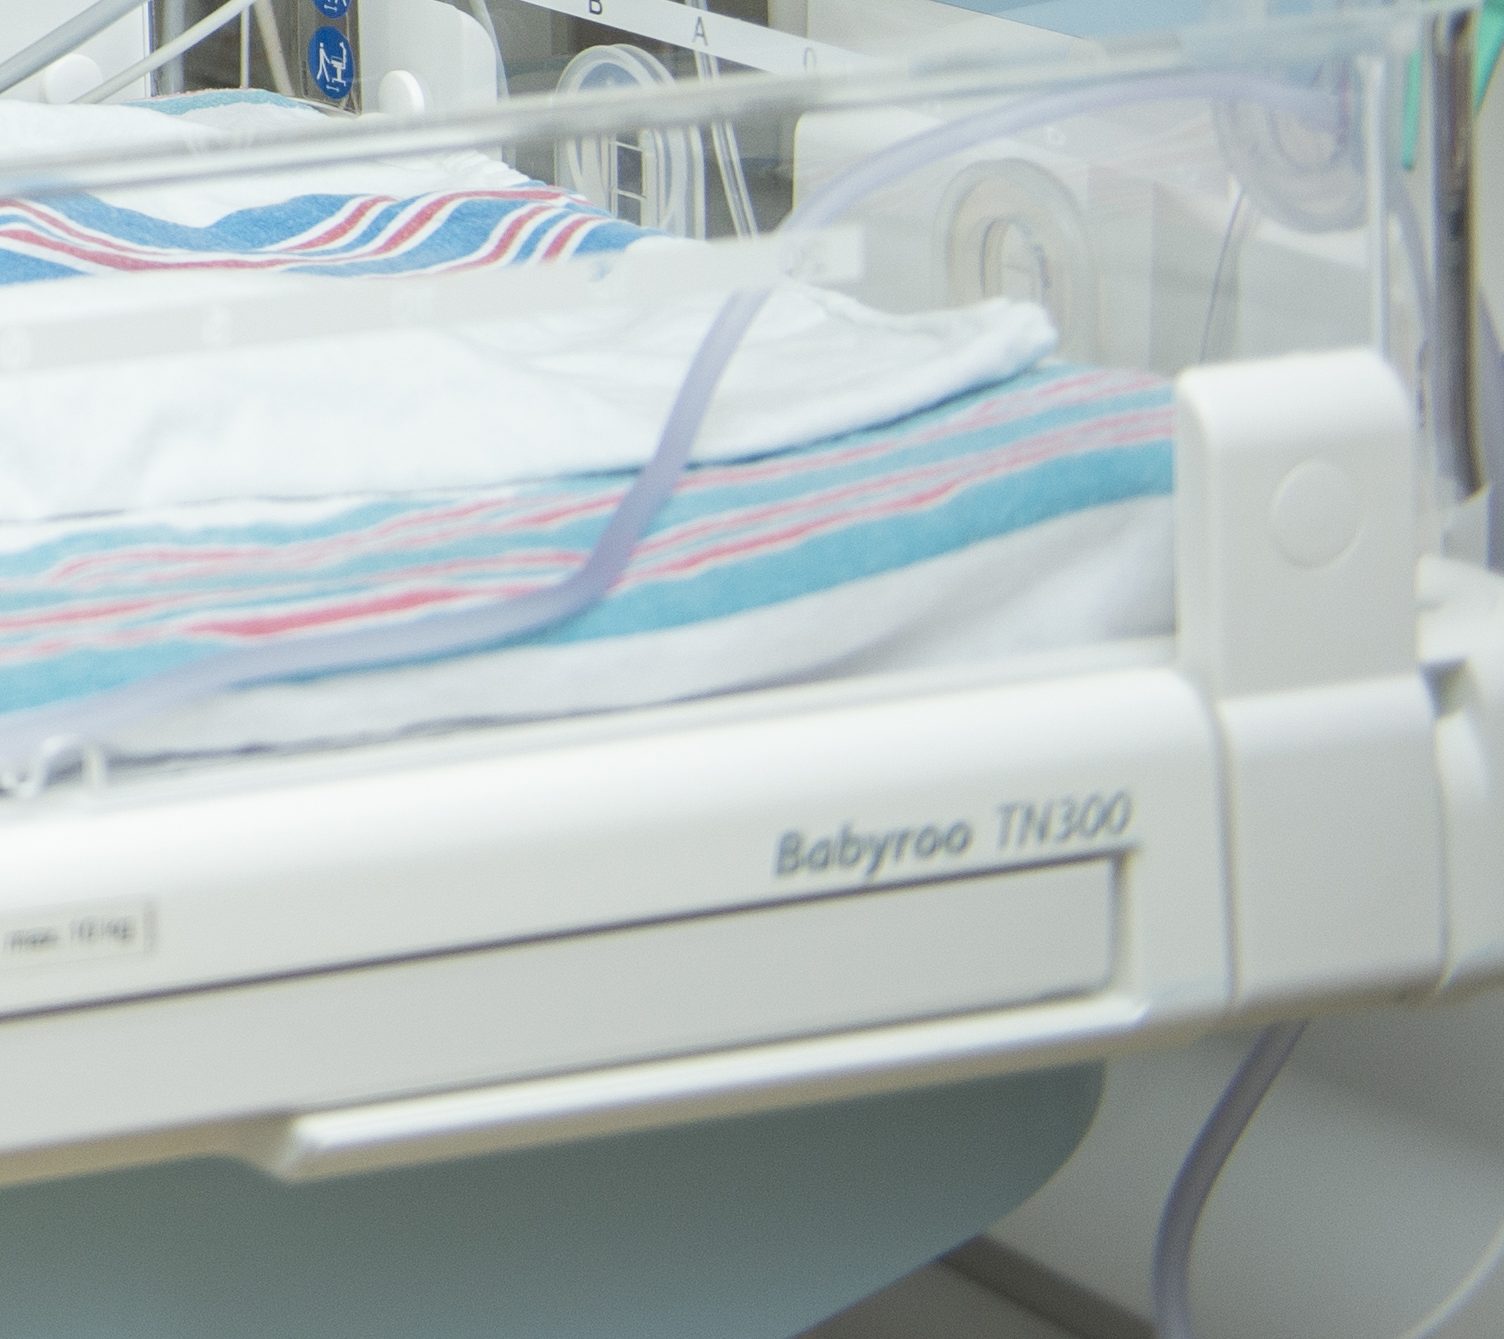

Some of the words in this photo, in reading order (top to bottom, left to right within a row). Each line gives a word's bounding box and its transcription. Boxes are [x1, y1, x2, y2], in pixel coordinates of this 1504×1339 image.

[691, 15, 709, 47] A
[774, 820, 974, 883] Babyroo
[997, 789, 1134, 850] TN300
